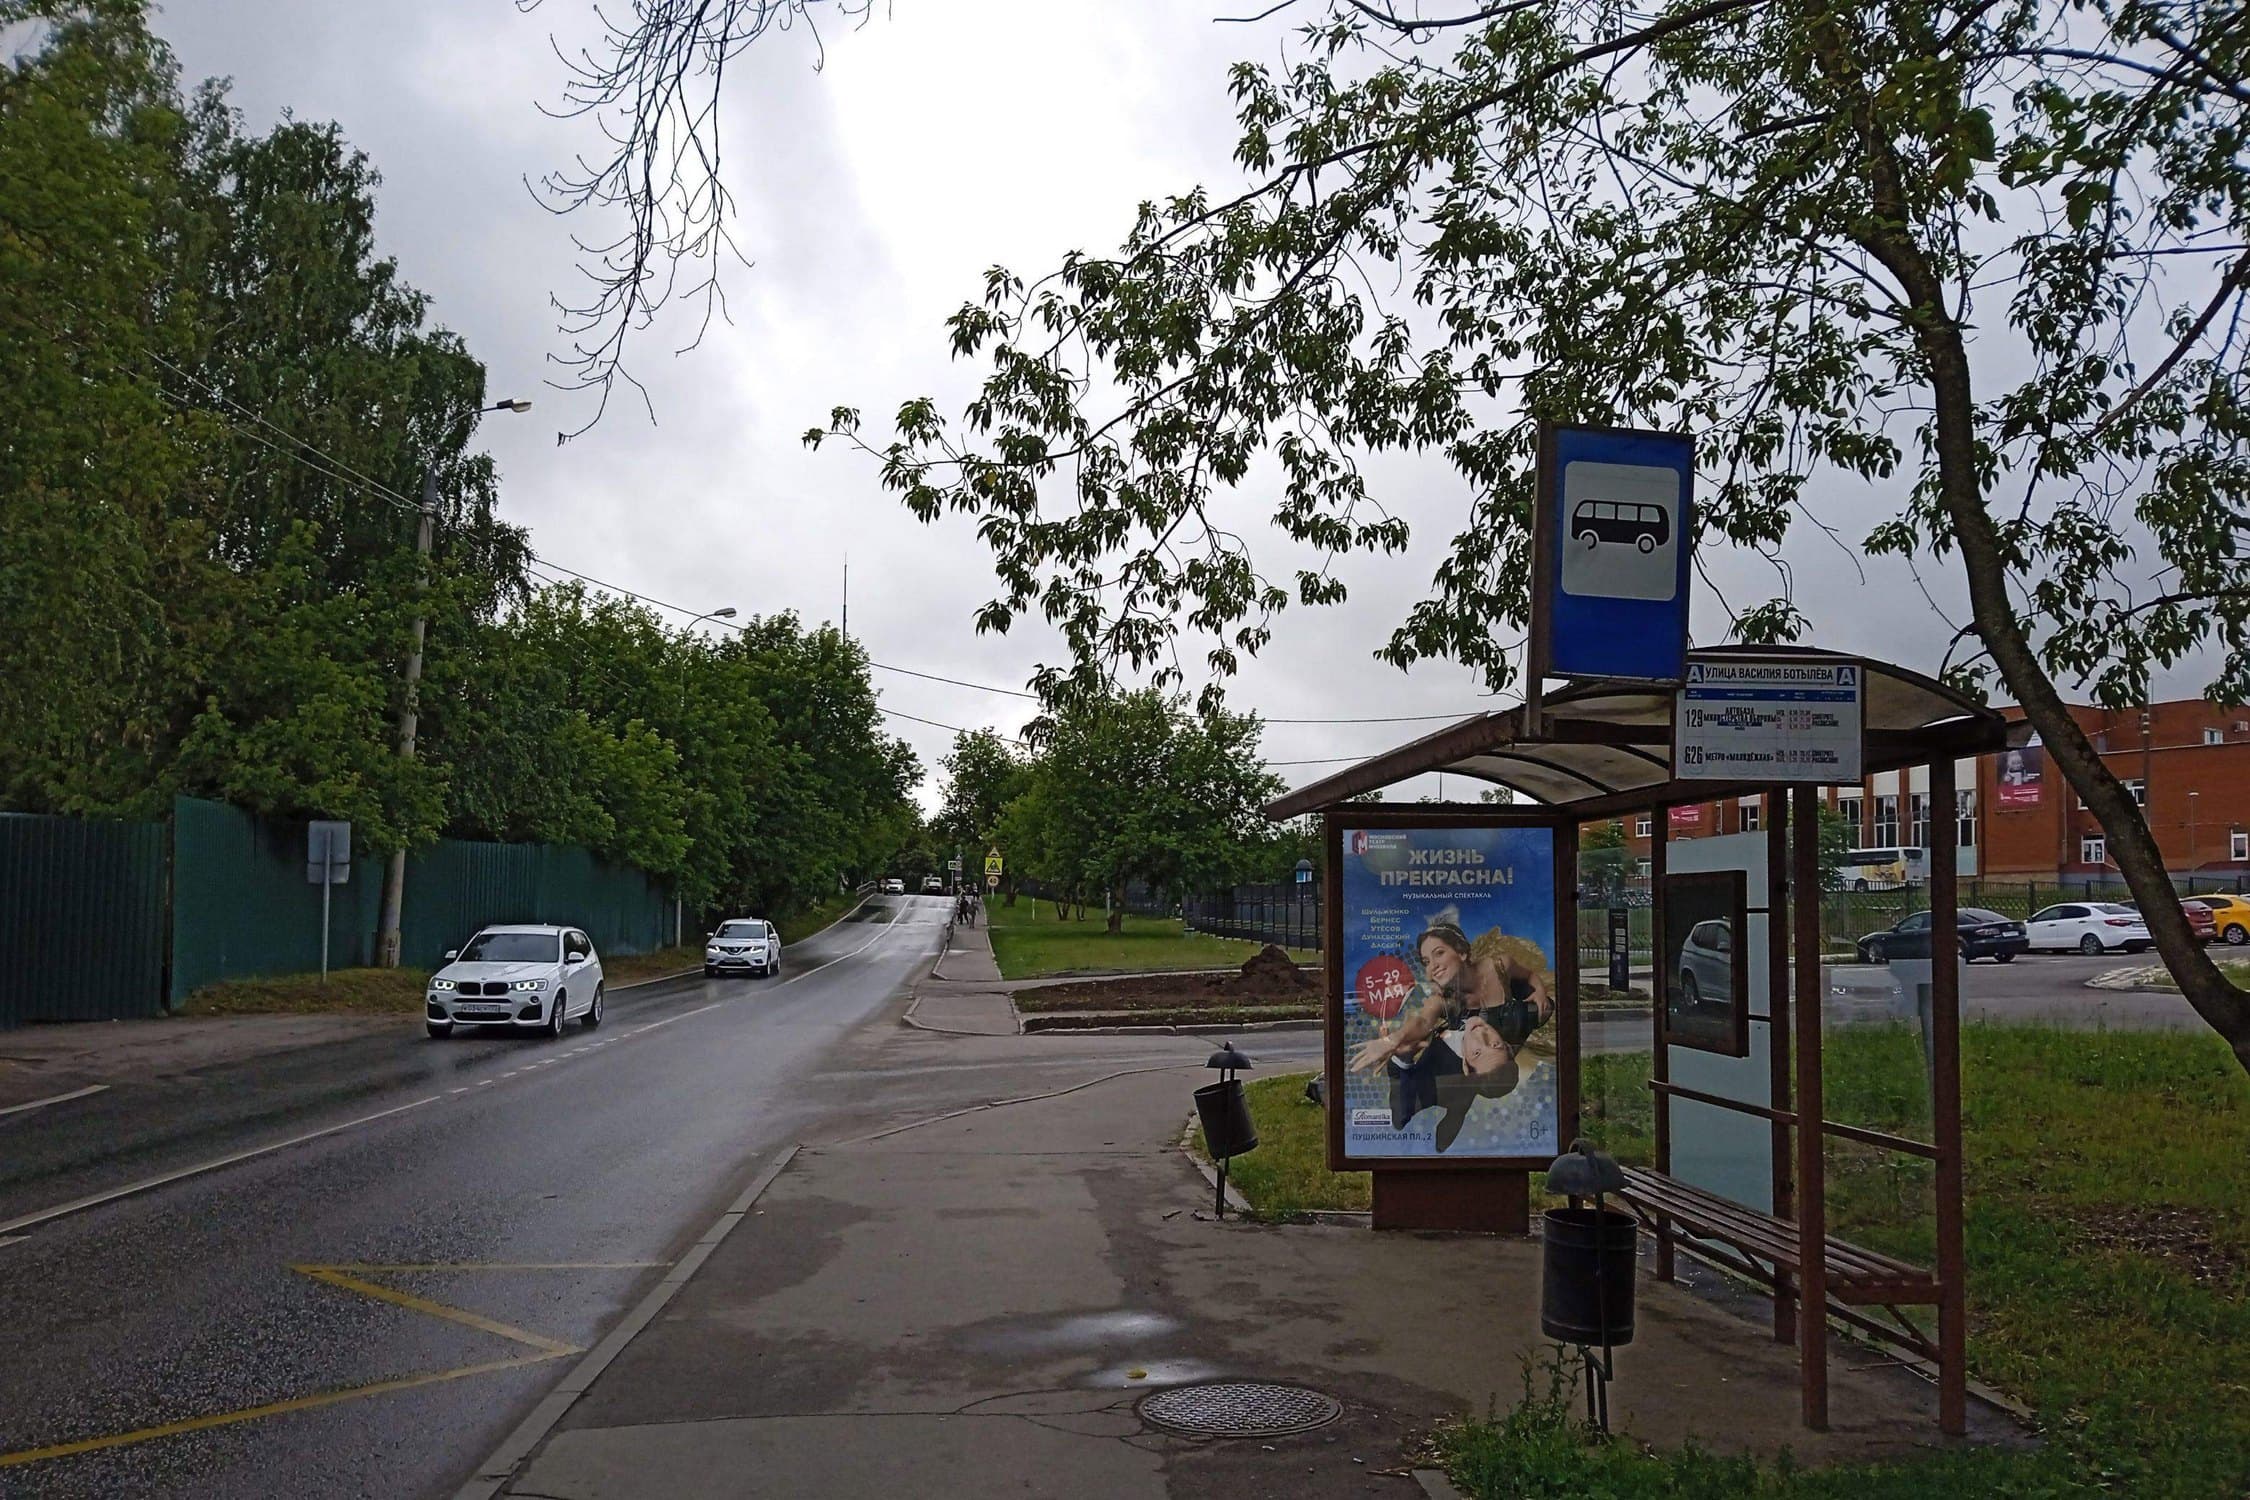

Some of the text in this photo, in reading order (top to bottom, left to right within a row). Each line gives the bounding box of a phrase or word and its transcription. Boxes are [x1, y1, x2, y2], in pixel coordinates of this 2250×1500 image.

[1705, 667, 1833, 680] УЛИЦА ВАСИЛИЯ БОТЫЛЁВА
[1685, 708, 1703, 728] 129
[1684, 746, 1703, 765] 626
[1705, 752, 1725, 761] МЕТРО
[1408, 848, 1485, 865] ЖИЗНЬ
[1380, 867, 1513, 886] ПРЕКРАСНА!
[1402, 891, 1453, 900] МУЗЫКАЛЬНЫЙ
[1368, 983, 1404, 1004] МАЯ
[1352, 1132, 1408, 1141] ПУШКИНСКАЯ
[1530, 1120, 1549, 1139] 6+
